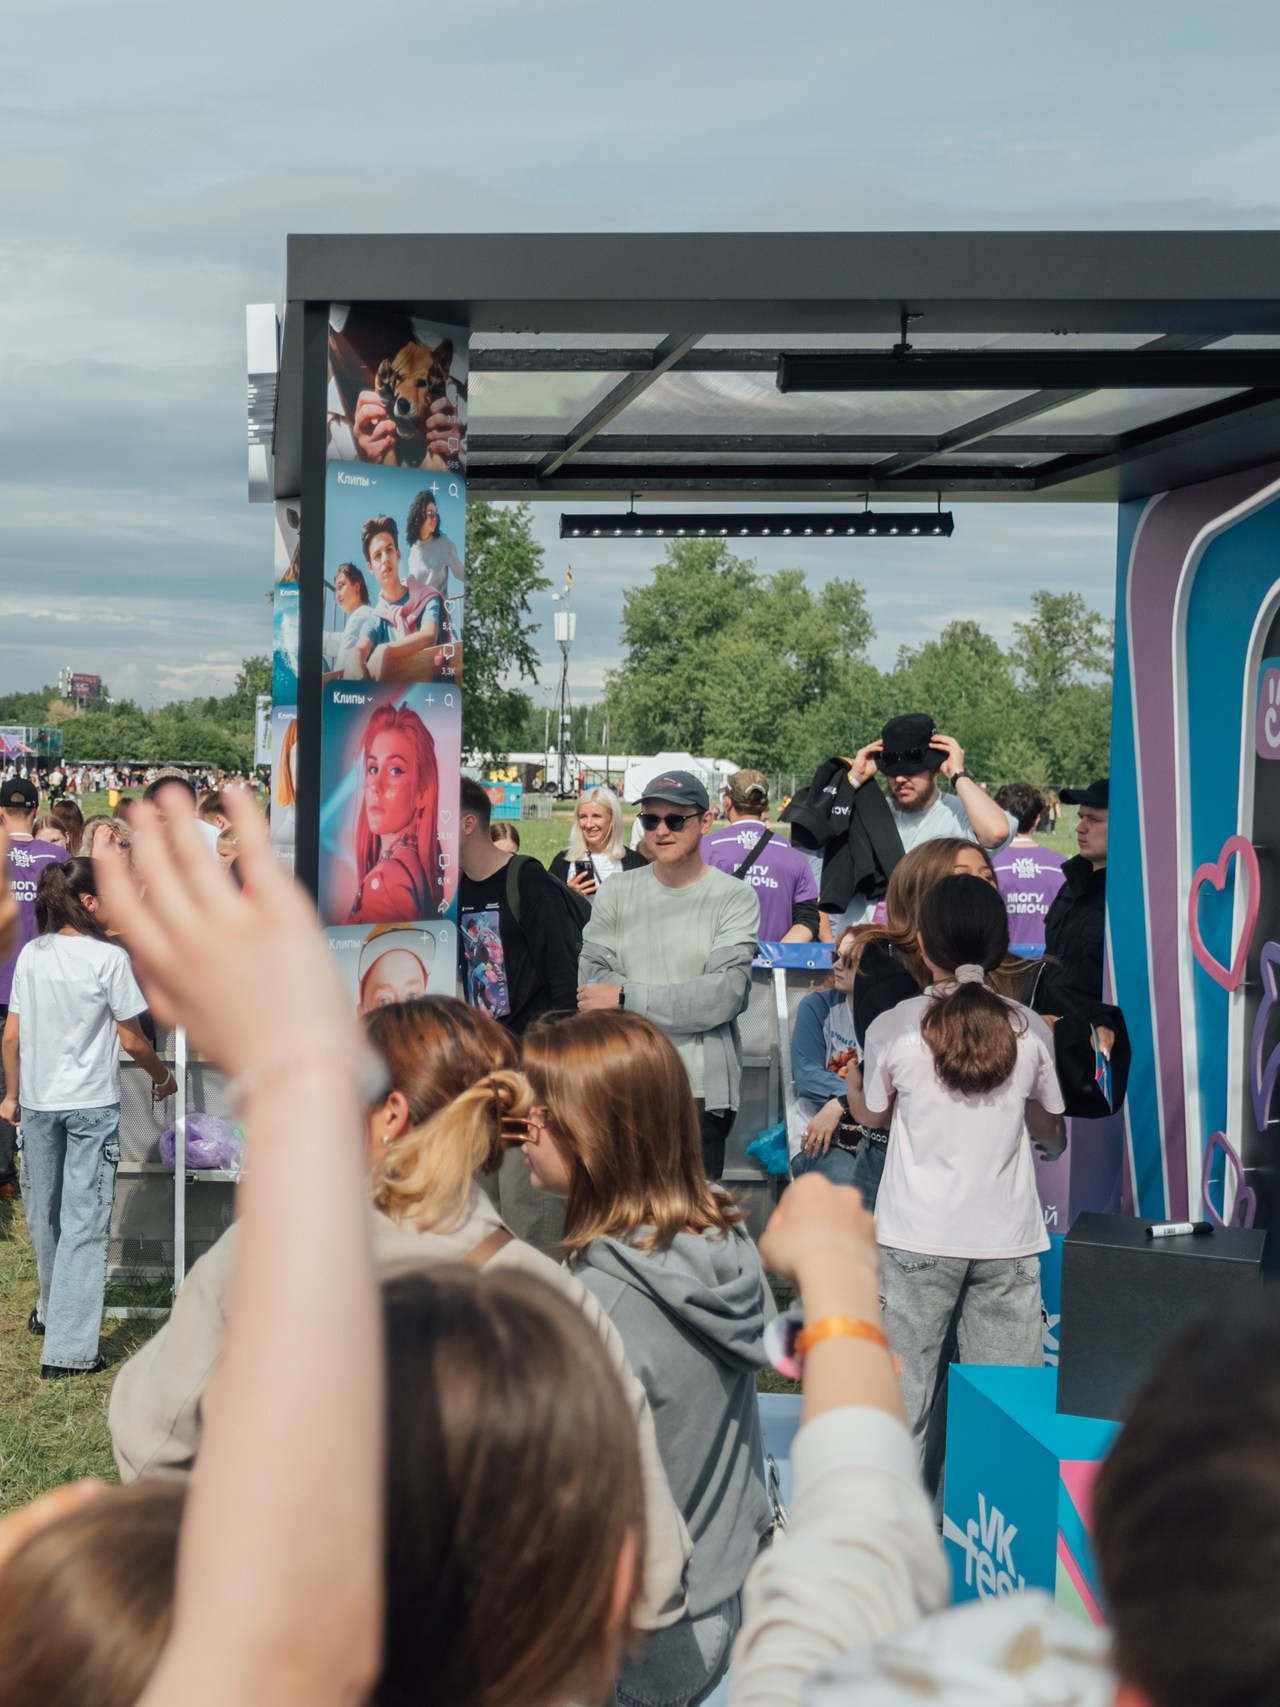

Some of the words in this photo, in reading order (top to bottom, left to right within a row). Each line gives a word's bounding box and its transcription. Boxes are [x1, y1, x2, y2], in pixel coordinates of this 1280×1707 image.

[337, 472, 369, 486] Клипы
[333, 691, 365, 704] Клипы
[1007, 892, 1044, 903] МОГУ
[328, 938, 361, 950] Клипы
[978, 1492, 1018, 1580] VK
